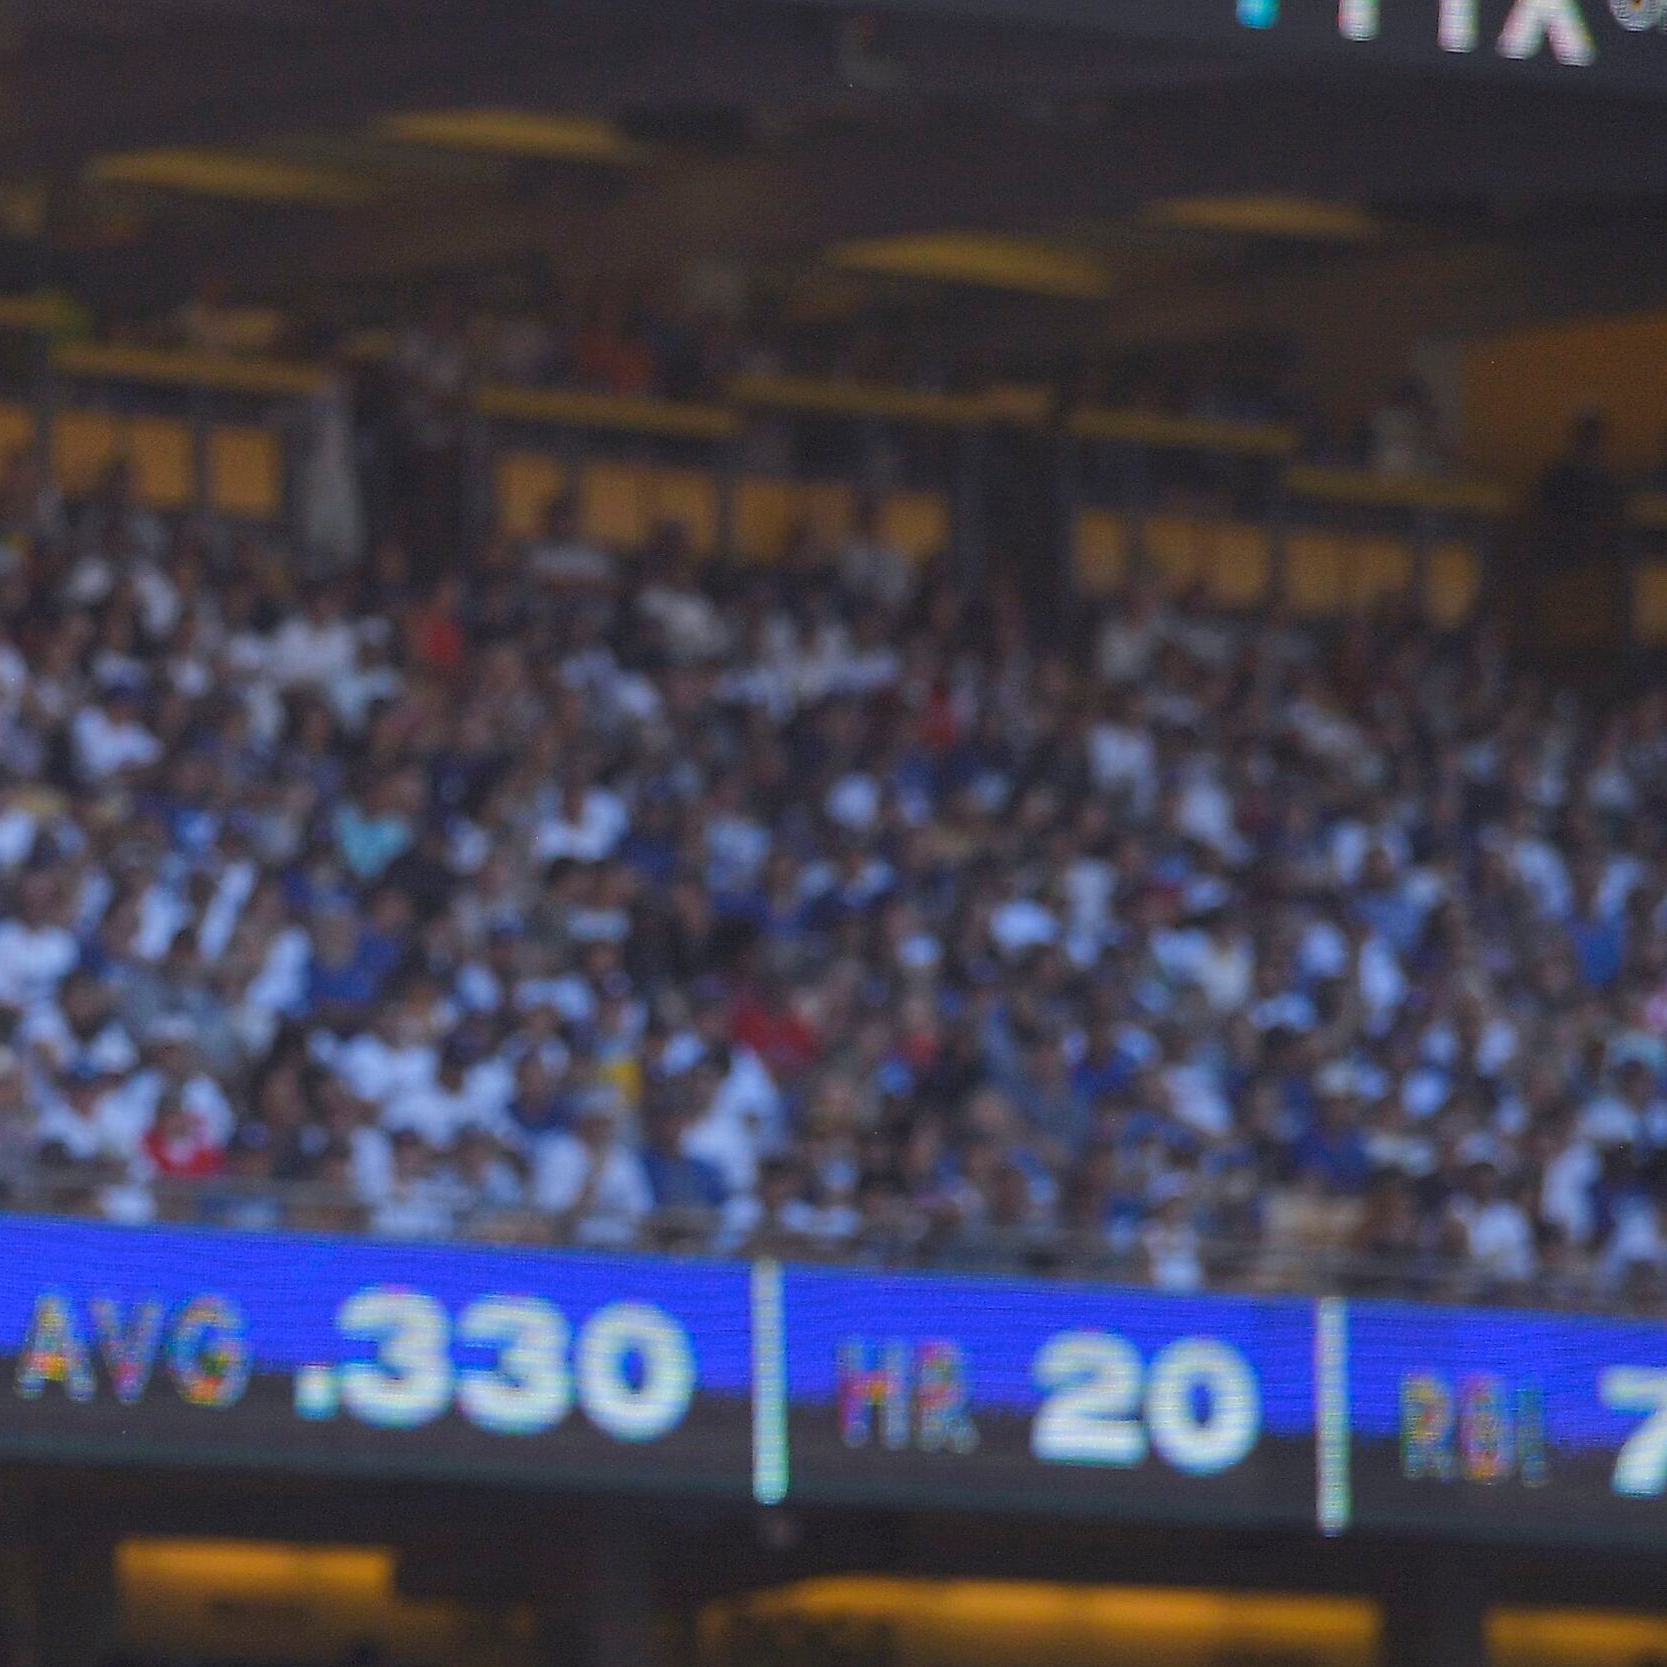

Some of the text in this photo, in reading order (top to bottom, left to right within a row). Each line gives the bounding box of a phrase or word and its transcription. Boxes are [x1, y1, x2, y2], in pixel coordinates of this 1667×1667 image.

[14, 1283, 699, 1443] AVG .330
[837, 1328, 1263, 1478] HR 20
[1399, 1372, 1551, 1488] RBI
